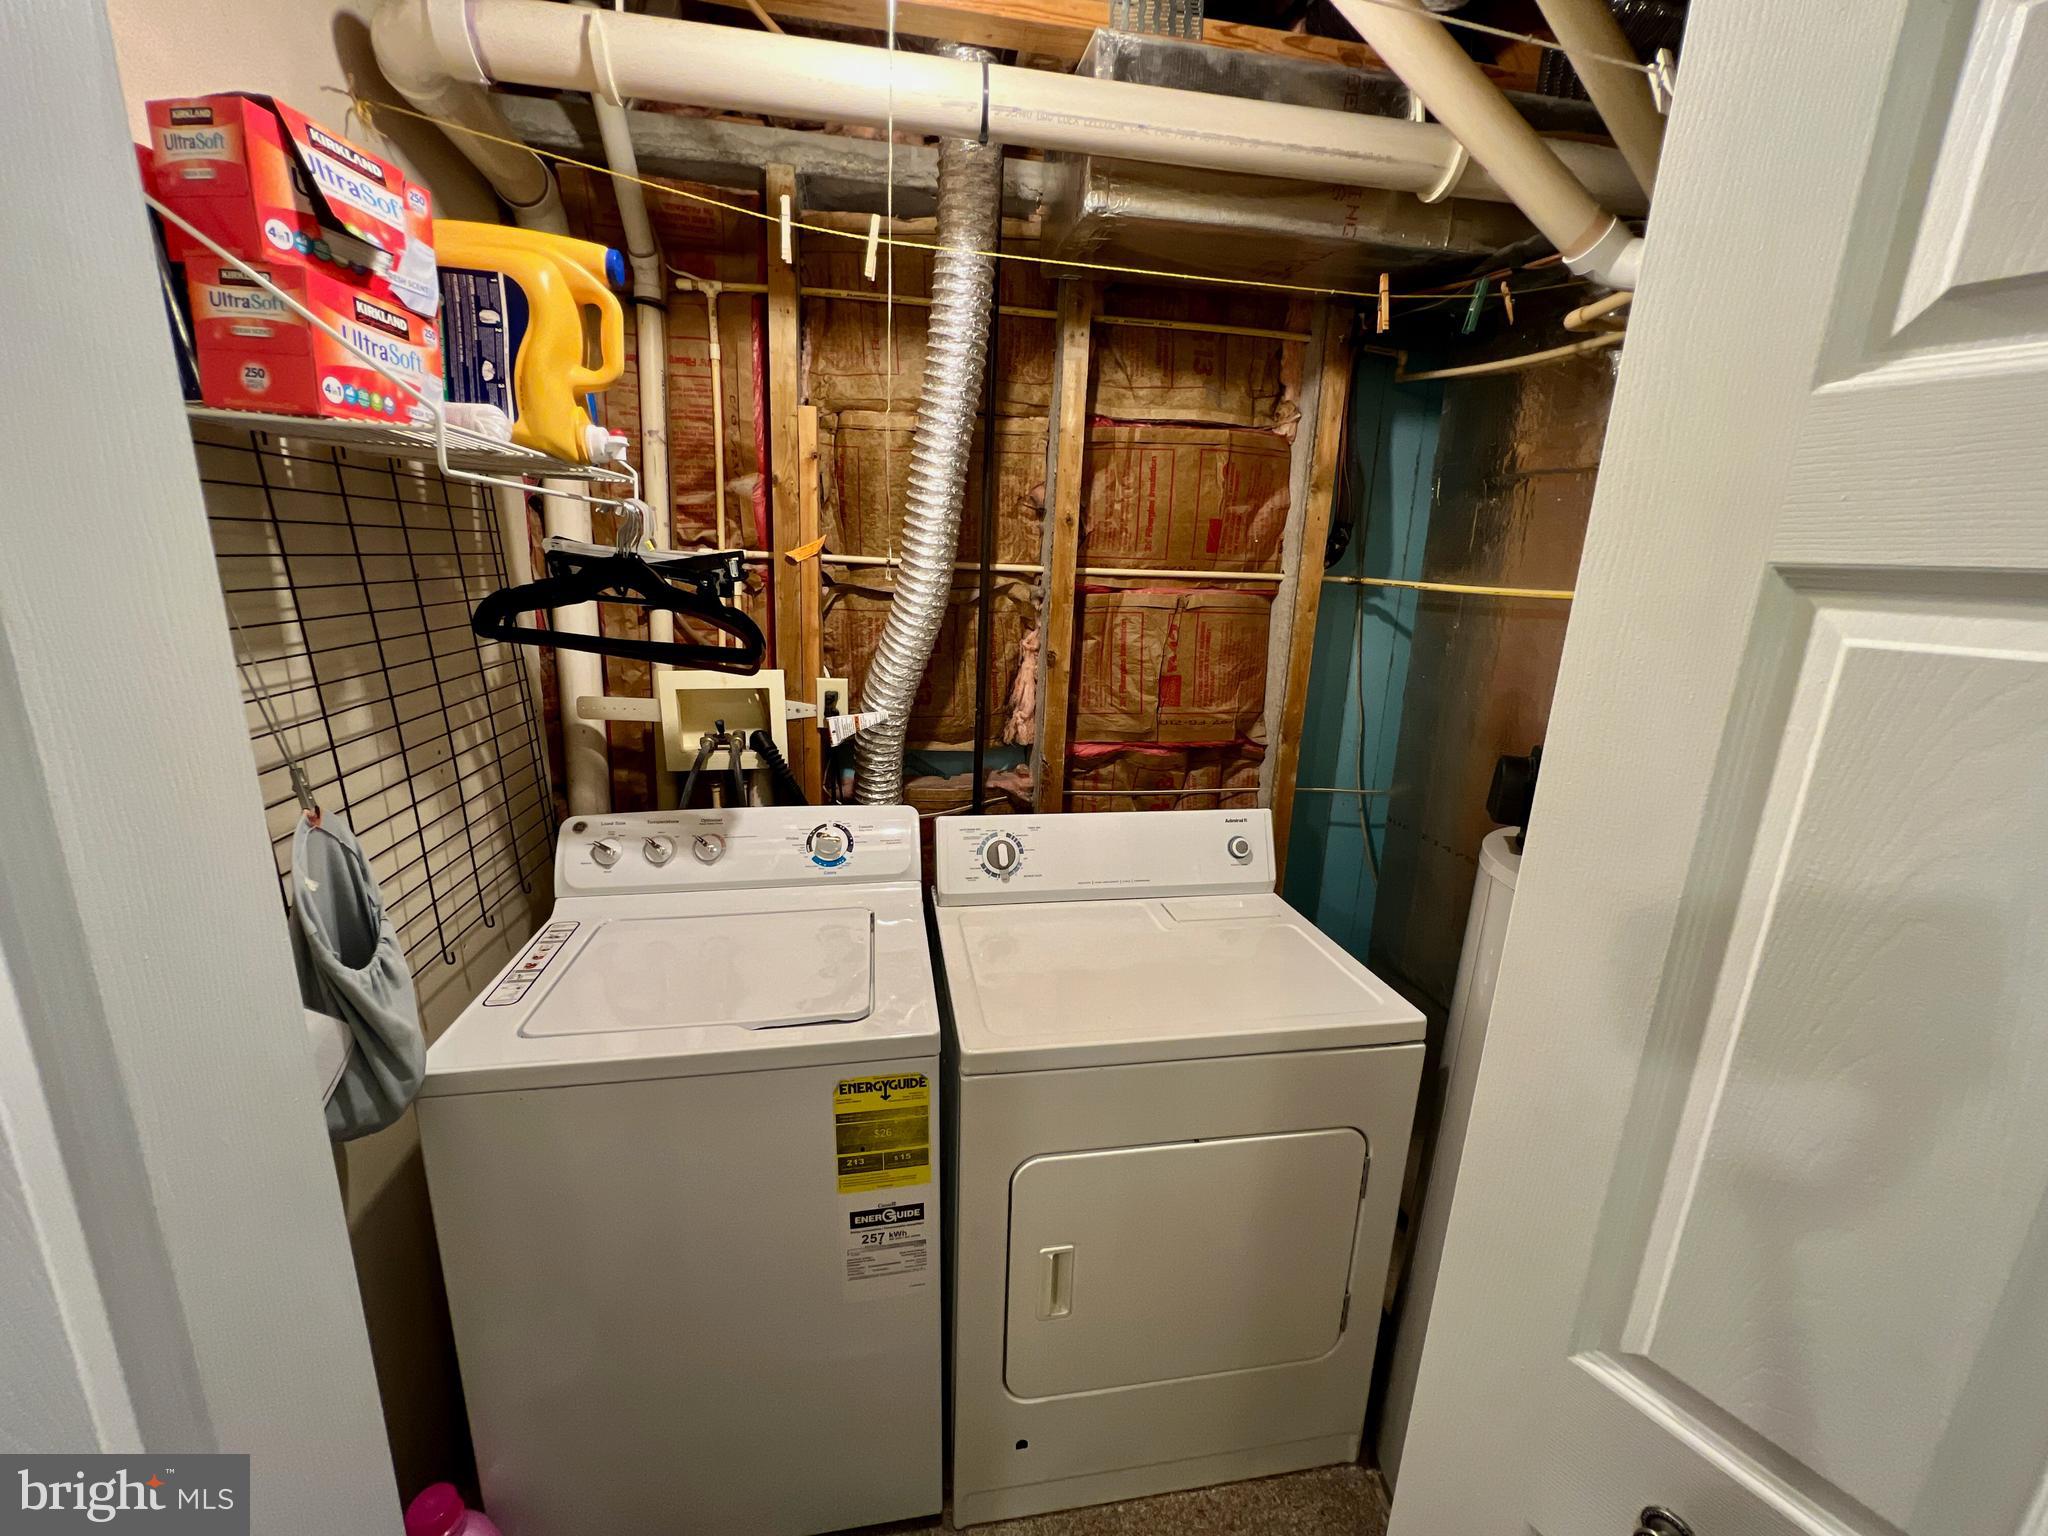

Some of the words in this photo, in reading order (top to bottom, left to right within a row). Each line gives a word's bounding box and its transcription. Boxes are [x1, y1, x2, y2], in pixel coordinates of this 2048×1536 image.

[171, 108, 212, 119] KIRKLAND
[163, 132, 225, 151] UltraSoft
[308, 127, 384, 179] KIRKLAND
[409, 191, 425, 206] 250
[208, 290, 286, 311] UltraSoft
[355, 299, 408, 331] KIRKLAND
[244, 366, 265, 379] 250
[839, 1077, 928, 1098] ENERGYGUIDE
[854, 1208, 921, 1225] ENERGUIDE
[861, 1232, 885, 1245] 257
[888, 1230, 908, 1241] kWh
